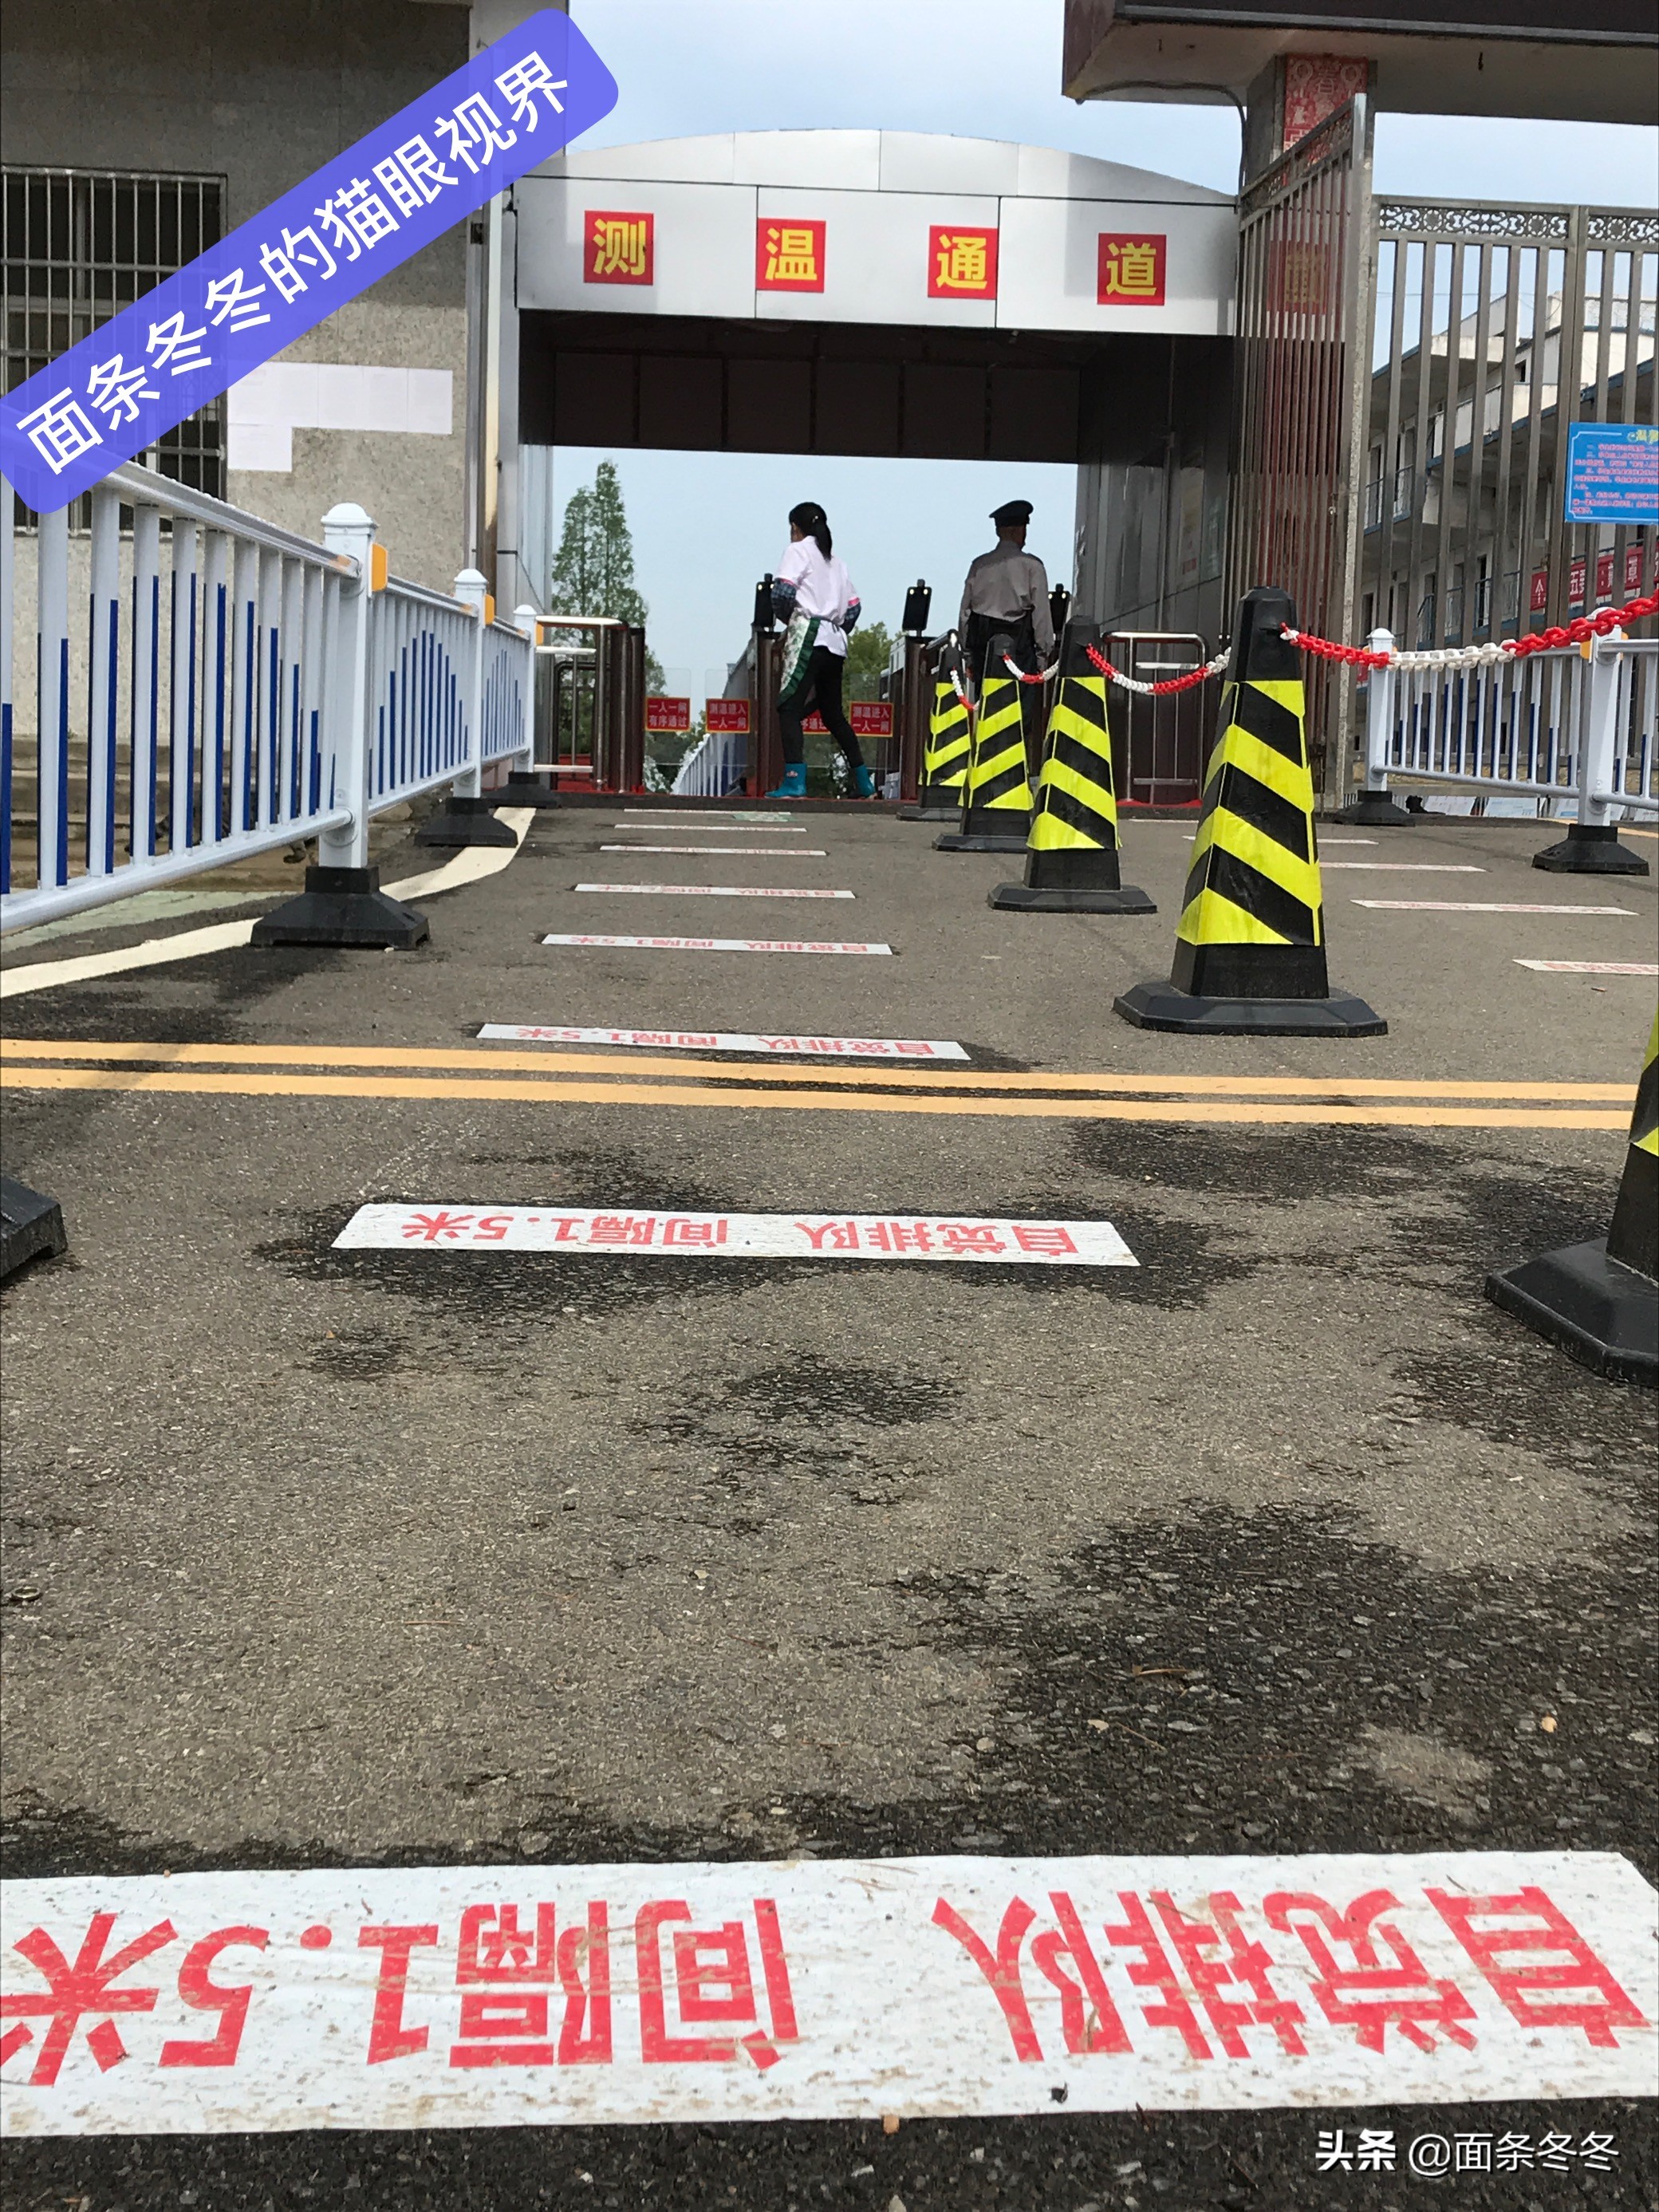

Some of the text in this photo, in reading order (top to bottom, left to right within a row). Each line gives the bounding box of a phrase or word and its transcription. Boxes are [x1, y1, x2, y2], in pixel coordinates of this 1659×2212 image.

[593, 218, 1157, 296] 测温通道
[759, 1038, 935, 1055] 自觉排队
[400, 1211, 1078, 1257] 自觉排队 间隔1.5米
[0, 1886, 1651, 2086] 自觉排队 间隔1.5米
